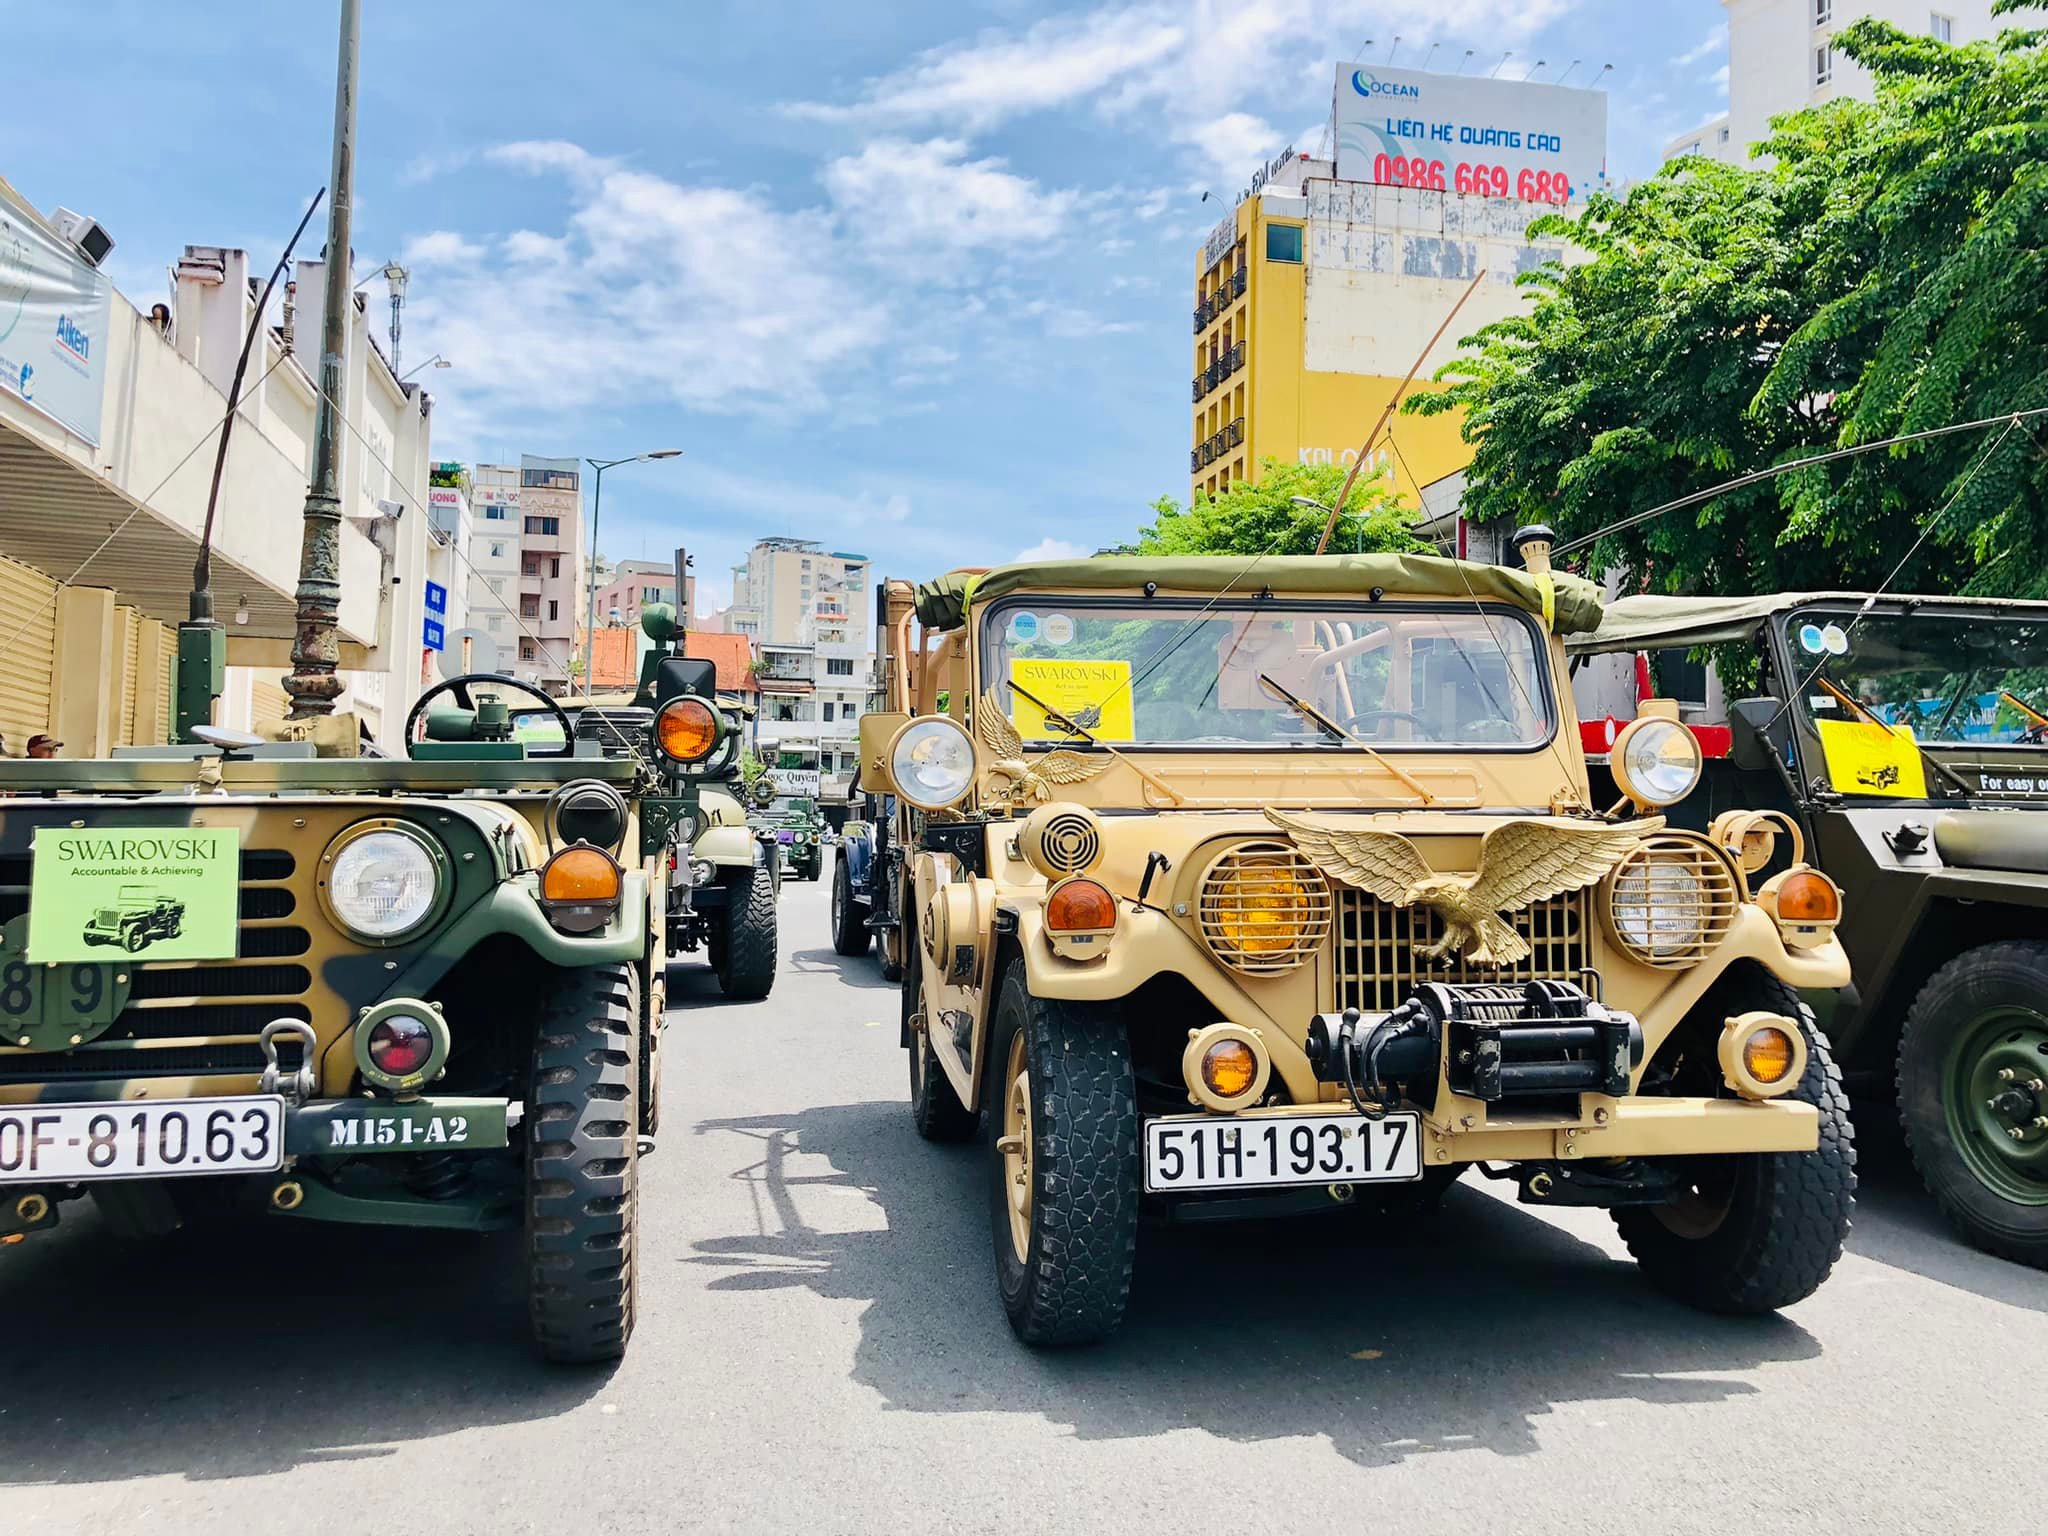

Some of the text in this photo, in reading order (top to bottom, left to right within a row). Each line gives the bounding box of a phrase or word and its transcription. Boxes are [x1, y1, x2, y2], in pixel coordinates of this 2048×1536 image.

[1371, 81, 1419, 98] OCEAN
[1374, 152, 1570, 205] 0986 669 689
[56, 313, 90, 359] Aiken
[1024, 666, 1118, 681] SWAROVSKI
[1979, 774, 2003, 790] For
[2006, 779, 2034, 793] easy
[58, 839, 217, 861] SWAROVSKI
[71, 866, 203, 877] Accountable & Achieving
[329, 1116, 468, 1146] M151-A2
[1157, 1120, 1409, 1181] 51H-193.17
